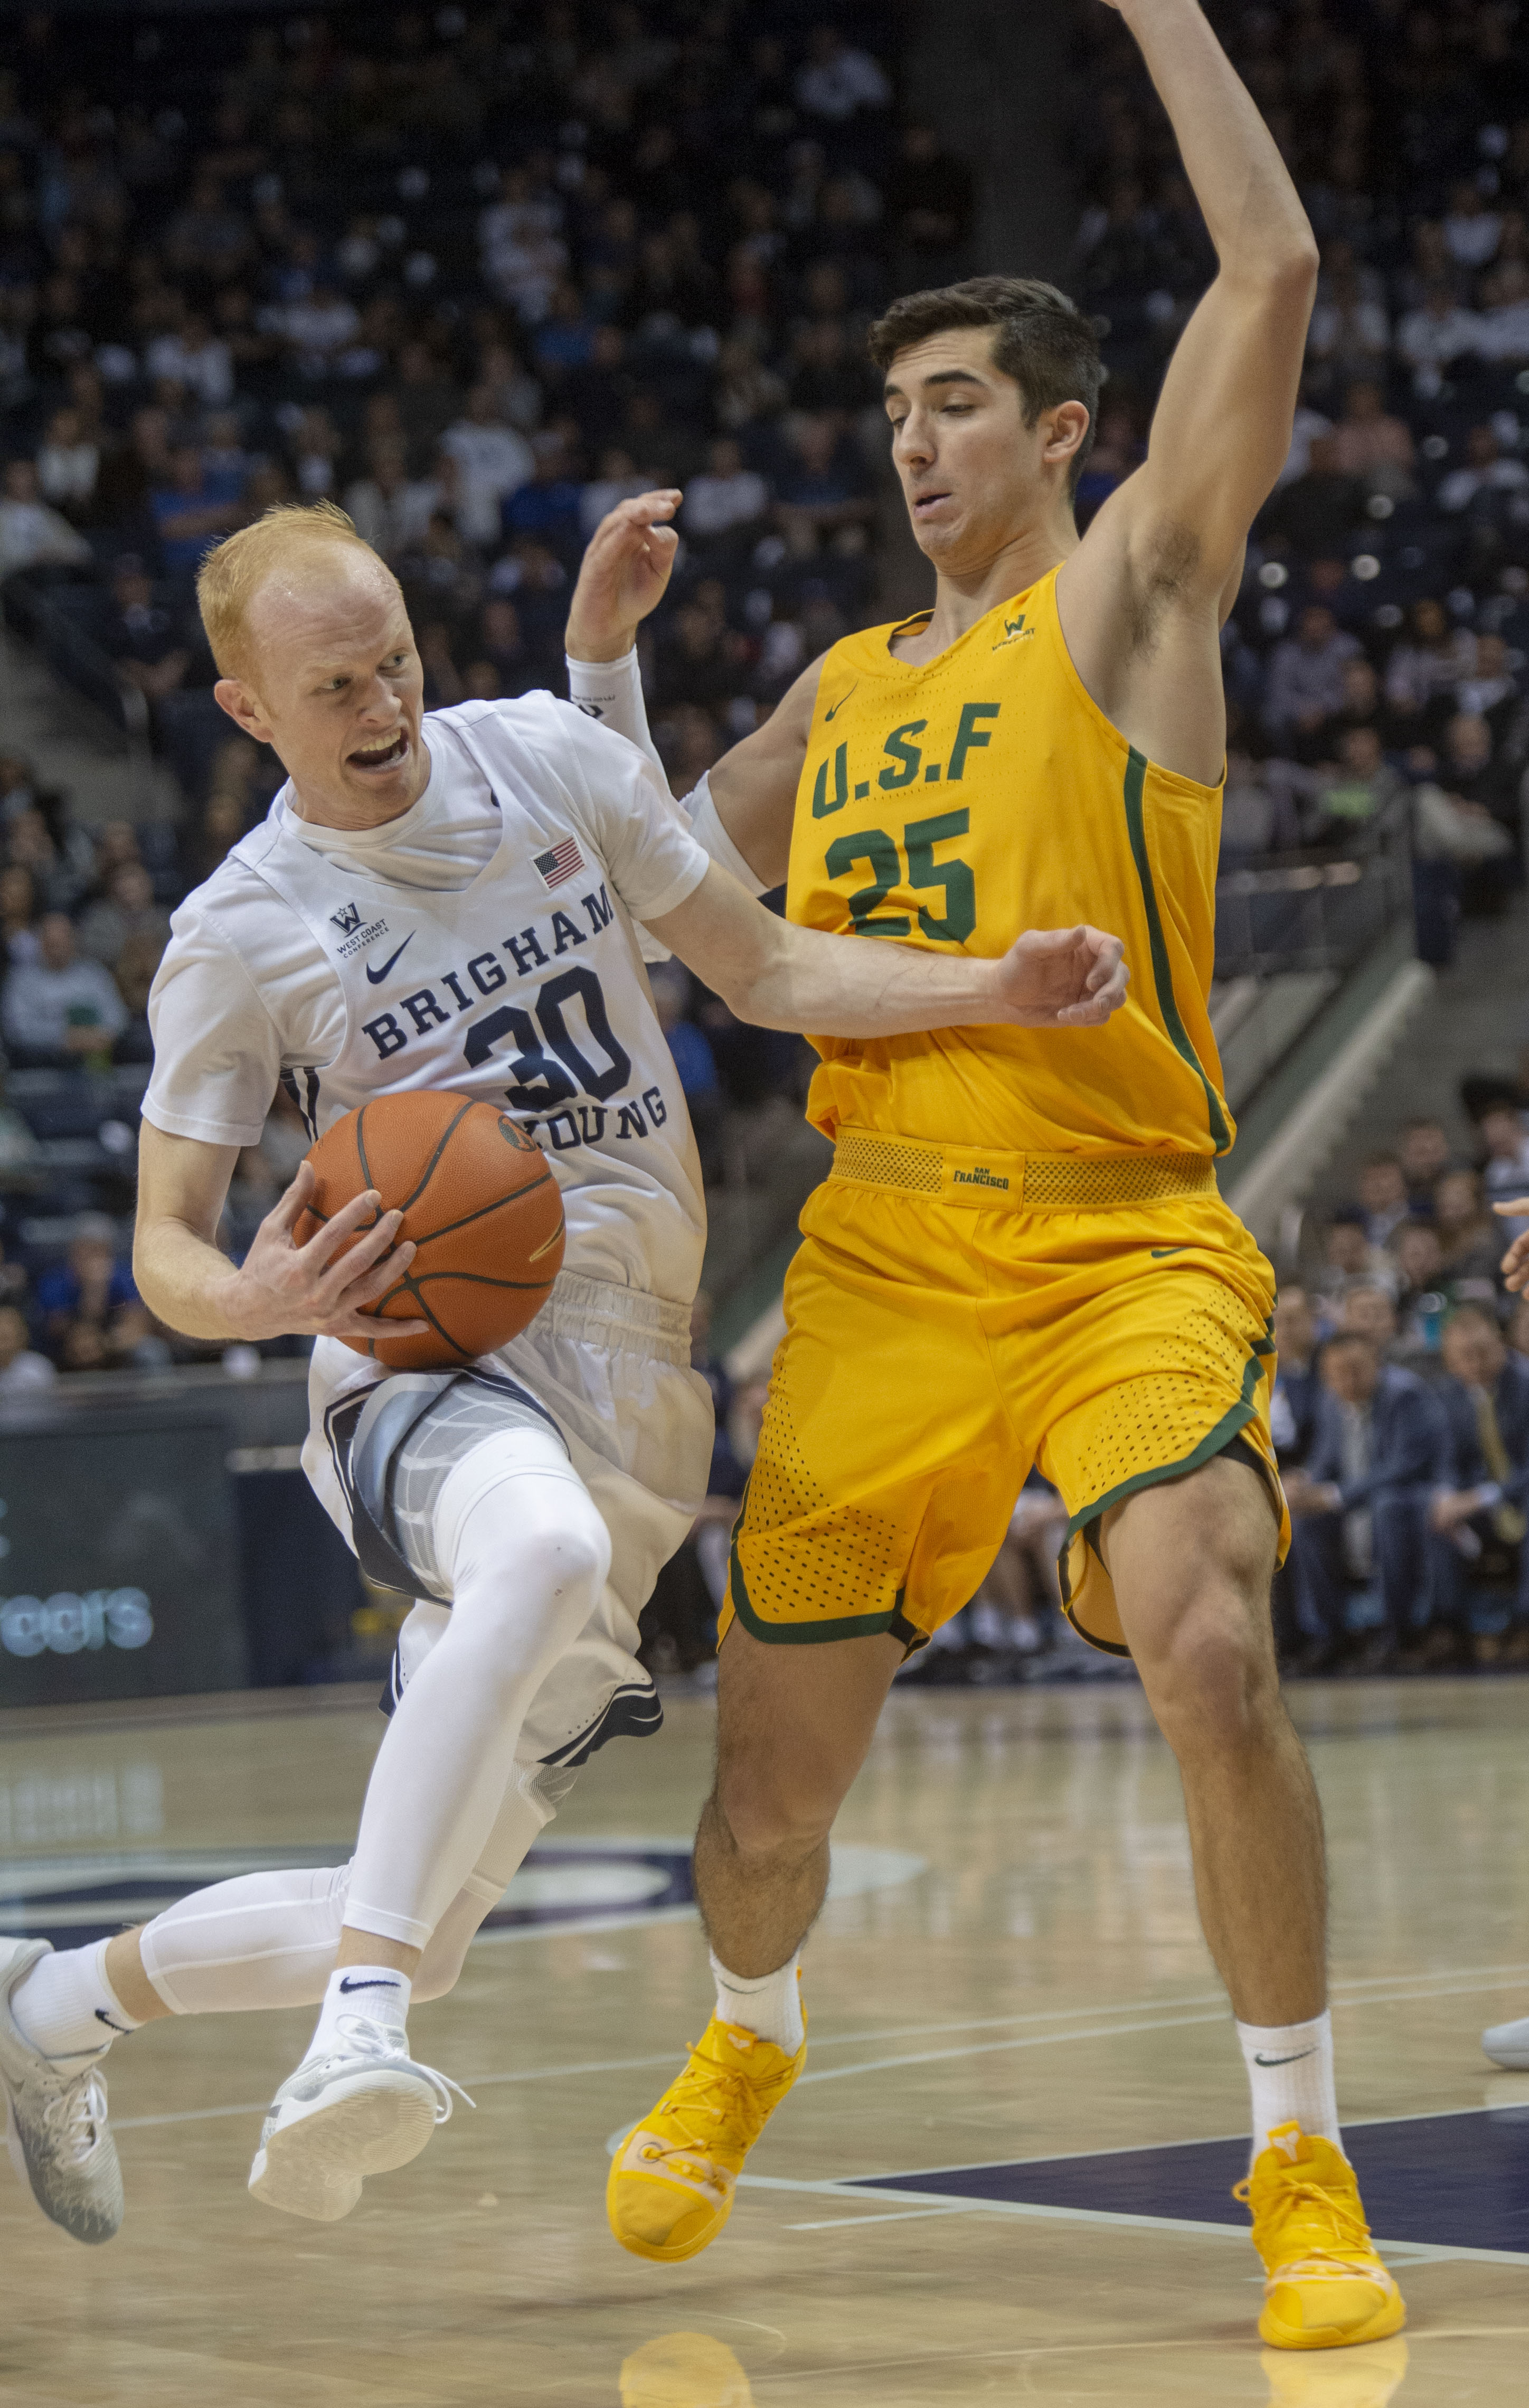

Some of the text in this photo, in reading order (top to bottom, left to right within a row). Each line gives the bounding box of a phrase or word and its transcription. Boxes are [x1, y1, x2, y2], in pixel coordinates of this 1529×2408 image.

[812, 703, 1001, 820] U.S.F
[824, 807, 977, 944] 25
[329, 902, 361, 933] W
[336, 918, 387, 954] WEST COAST
[343, 926, 390, 958] CONFERENCE
[362, 882, 615, 1060] BRIGHAM
[463, 966, 631, 1112] 30
[953, 1170, 1009, 1190] FRANCISCO
[0, 1586, 153, 1657] eers
